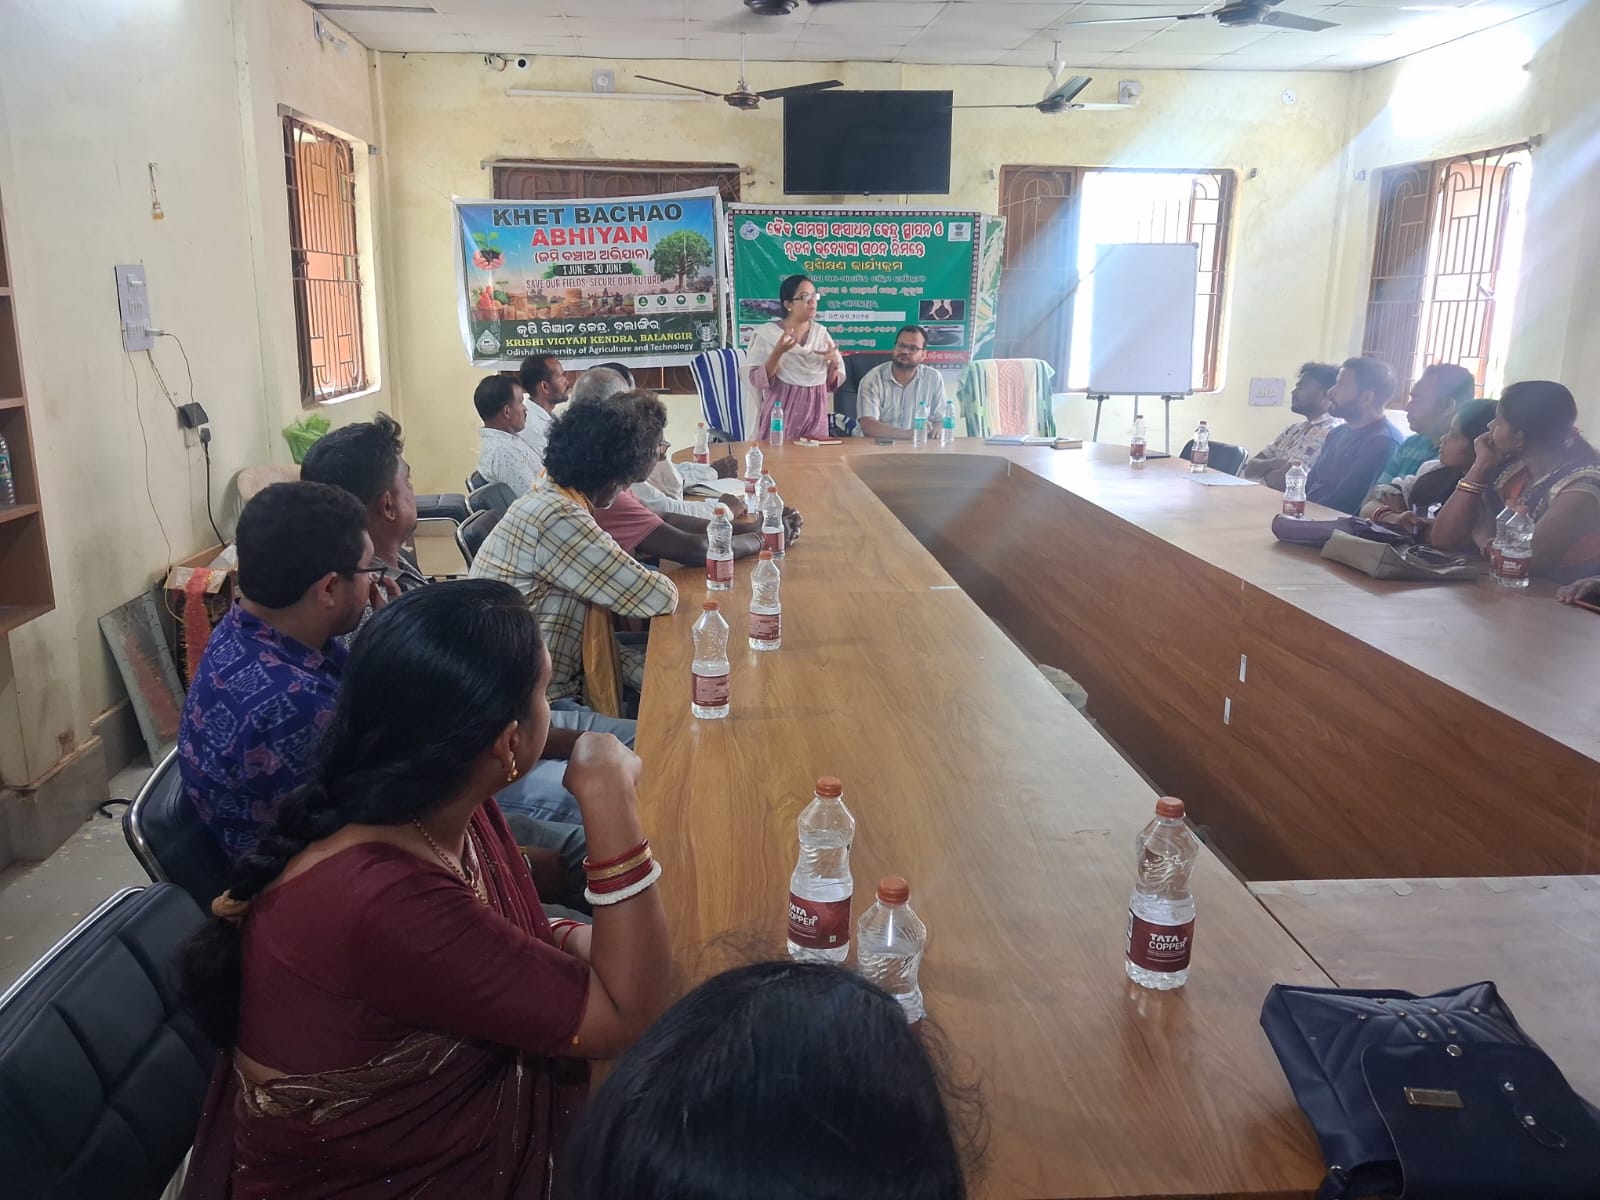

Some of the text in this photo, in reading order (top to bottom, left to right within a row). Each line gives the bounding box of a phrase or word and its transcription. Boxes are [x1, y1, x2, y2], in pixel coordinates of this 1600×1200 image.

[493, 203, 682, 227] KHET BACHAO
[531, 225, 648, 247] ABHIYAN
[568, 264, 586, 275] JUNE
[594, 264, 604, 274] 30
[605, 263, 623, 274] JUNE
[526, 279, 545, 289] SAVE
[546, 279, 560, 289] OUR
[590, 277, 616, 287] SECURE
[617, 276, 632, 286] OUR
[634, 275, 661, 285] FUTURE
[505, 331, 693, 347] KRISHI VIGYAN KENDRA, BALANGIR
[578, 346, 587, 354] of
[588, 345, 632, 355] Agriculture
[633, 344, 648, 352] and
[650, 342, 693, 352] Technology
[1149, 933, 1179, 942] TATA
